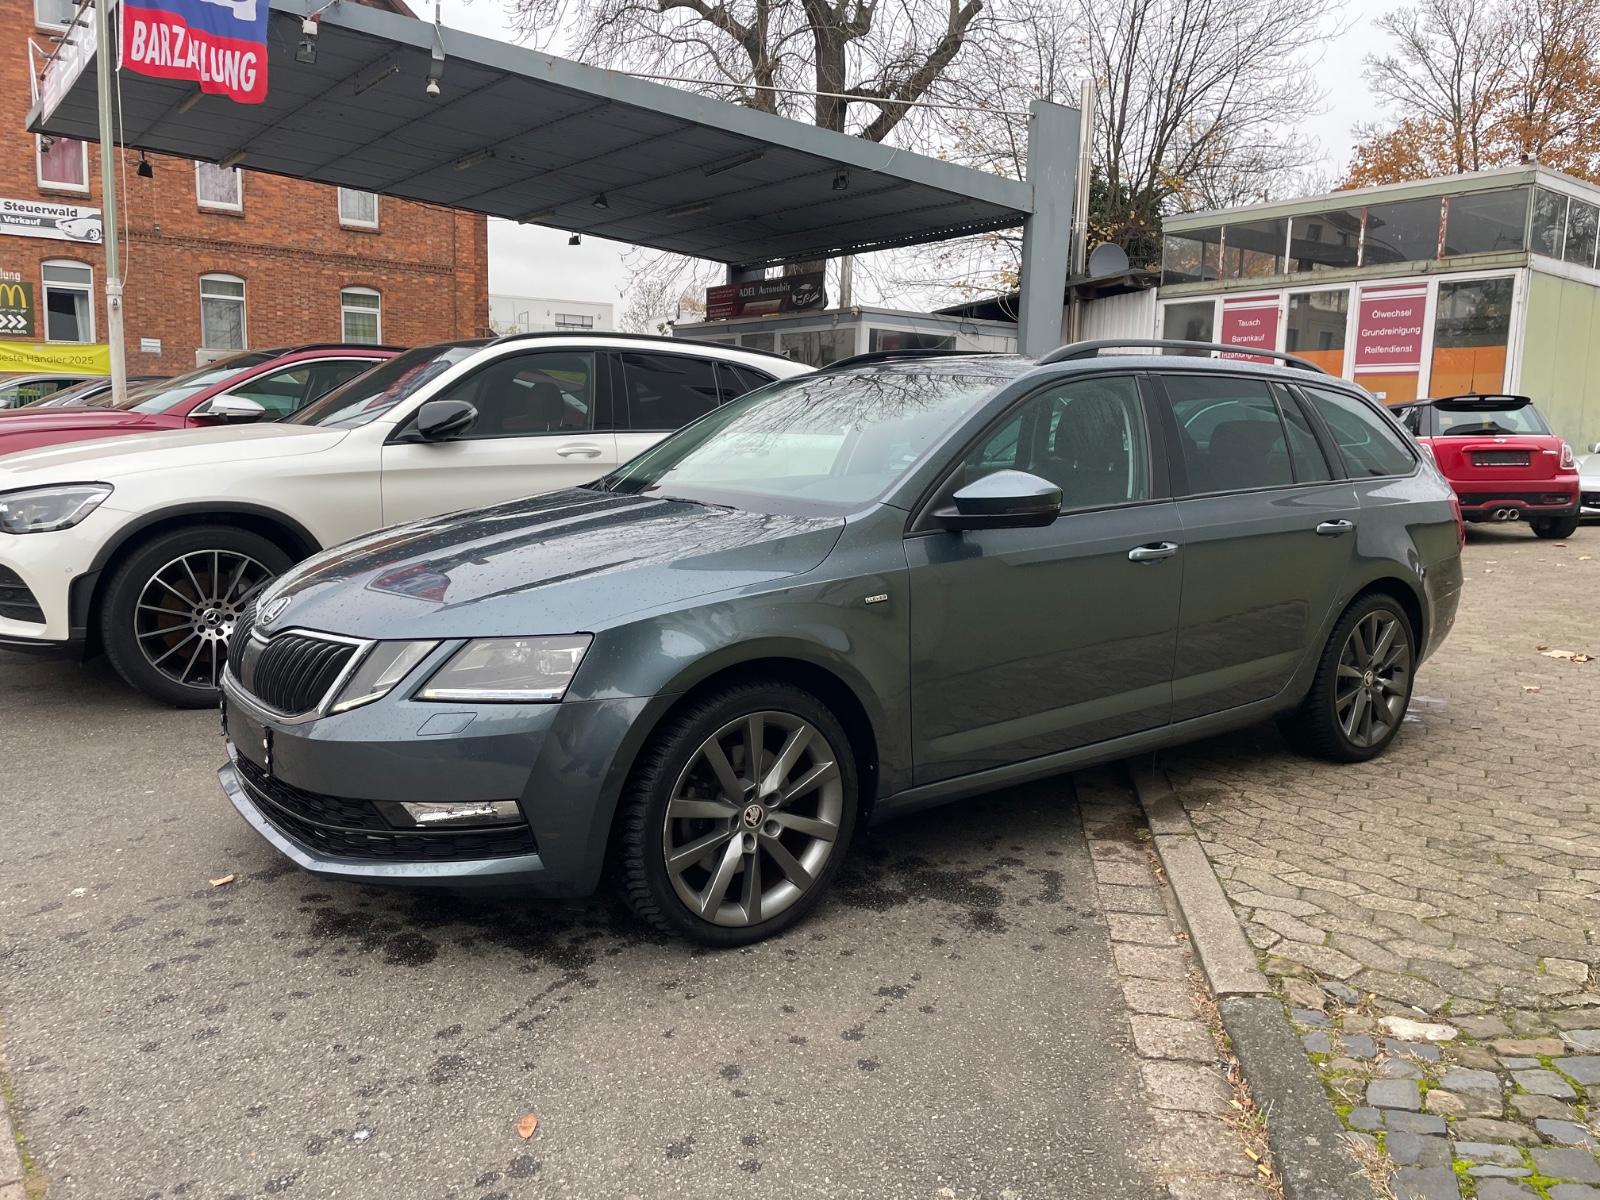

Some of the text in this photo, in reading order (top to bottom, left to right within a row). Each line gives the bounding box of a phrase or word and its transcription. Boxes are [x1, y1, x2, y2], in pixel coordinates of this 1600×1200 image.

[4, 201, 79, 217] Steuerwald
[3, 214, 42, 226] Verkauf
[1371, 308, 1412, 319] Ölwechsel
[1237, 318, 1261, 327] Tausch
[1361, 326, 1421, 337] Grundreinigung
[1231, 333, 1265, 343] Barankauf
[1364, 344, 1413, 354] Reifendienst
[68, 355, 94, 365] 2025
